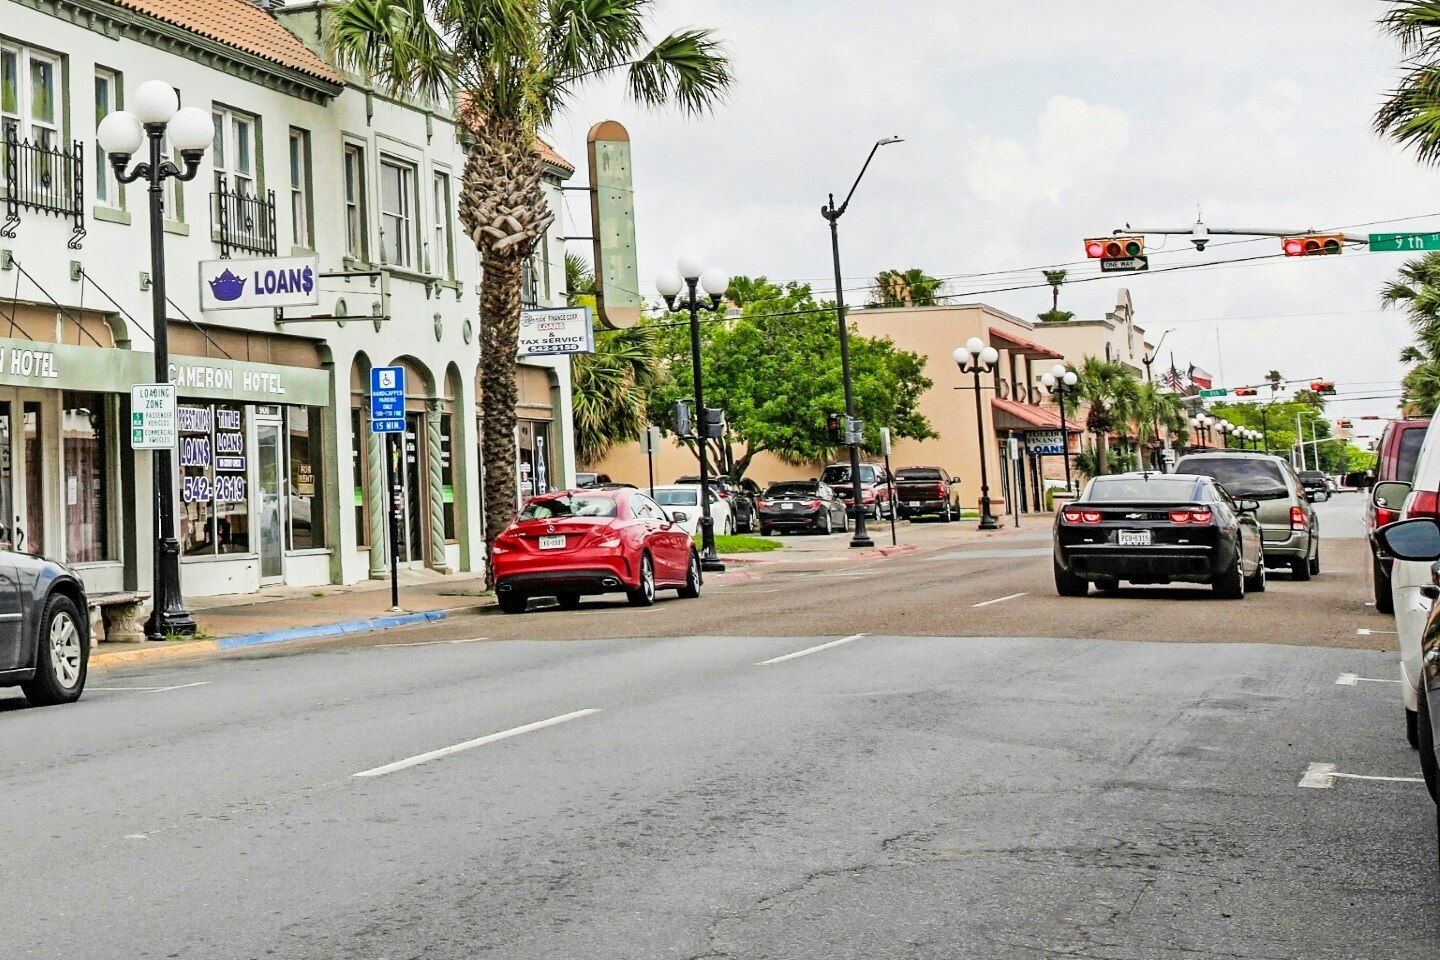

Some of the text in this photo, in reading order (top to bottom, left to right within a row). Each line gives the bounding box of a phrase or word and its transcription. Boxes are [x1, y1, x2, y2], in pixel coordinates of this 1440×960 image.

[254, 265, 314, 296] LOAN$
[542, 336, 585, 344] SERVICE
[9, 349, 58, 379] HOTEL
[168, 363, 285, 395] CAMERON HOTEL
[140, 388, 170, 398] LOADING
[145, 400, 163, 409] ZONE
[216, 409, 240, 430] TITLE
[376, 422, 384, 430] 15
[1026, 445, 1065, 454] LOANS
[300, 466, 311, 474] FOR
